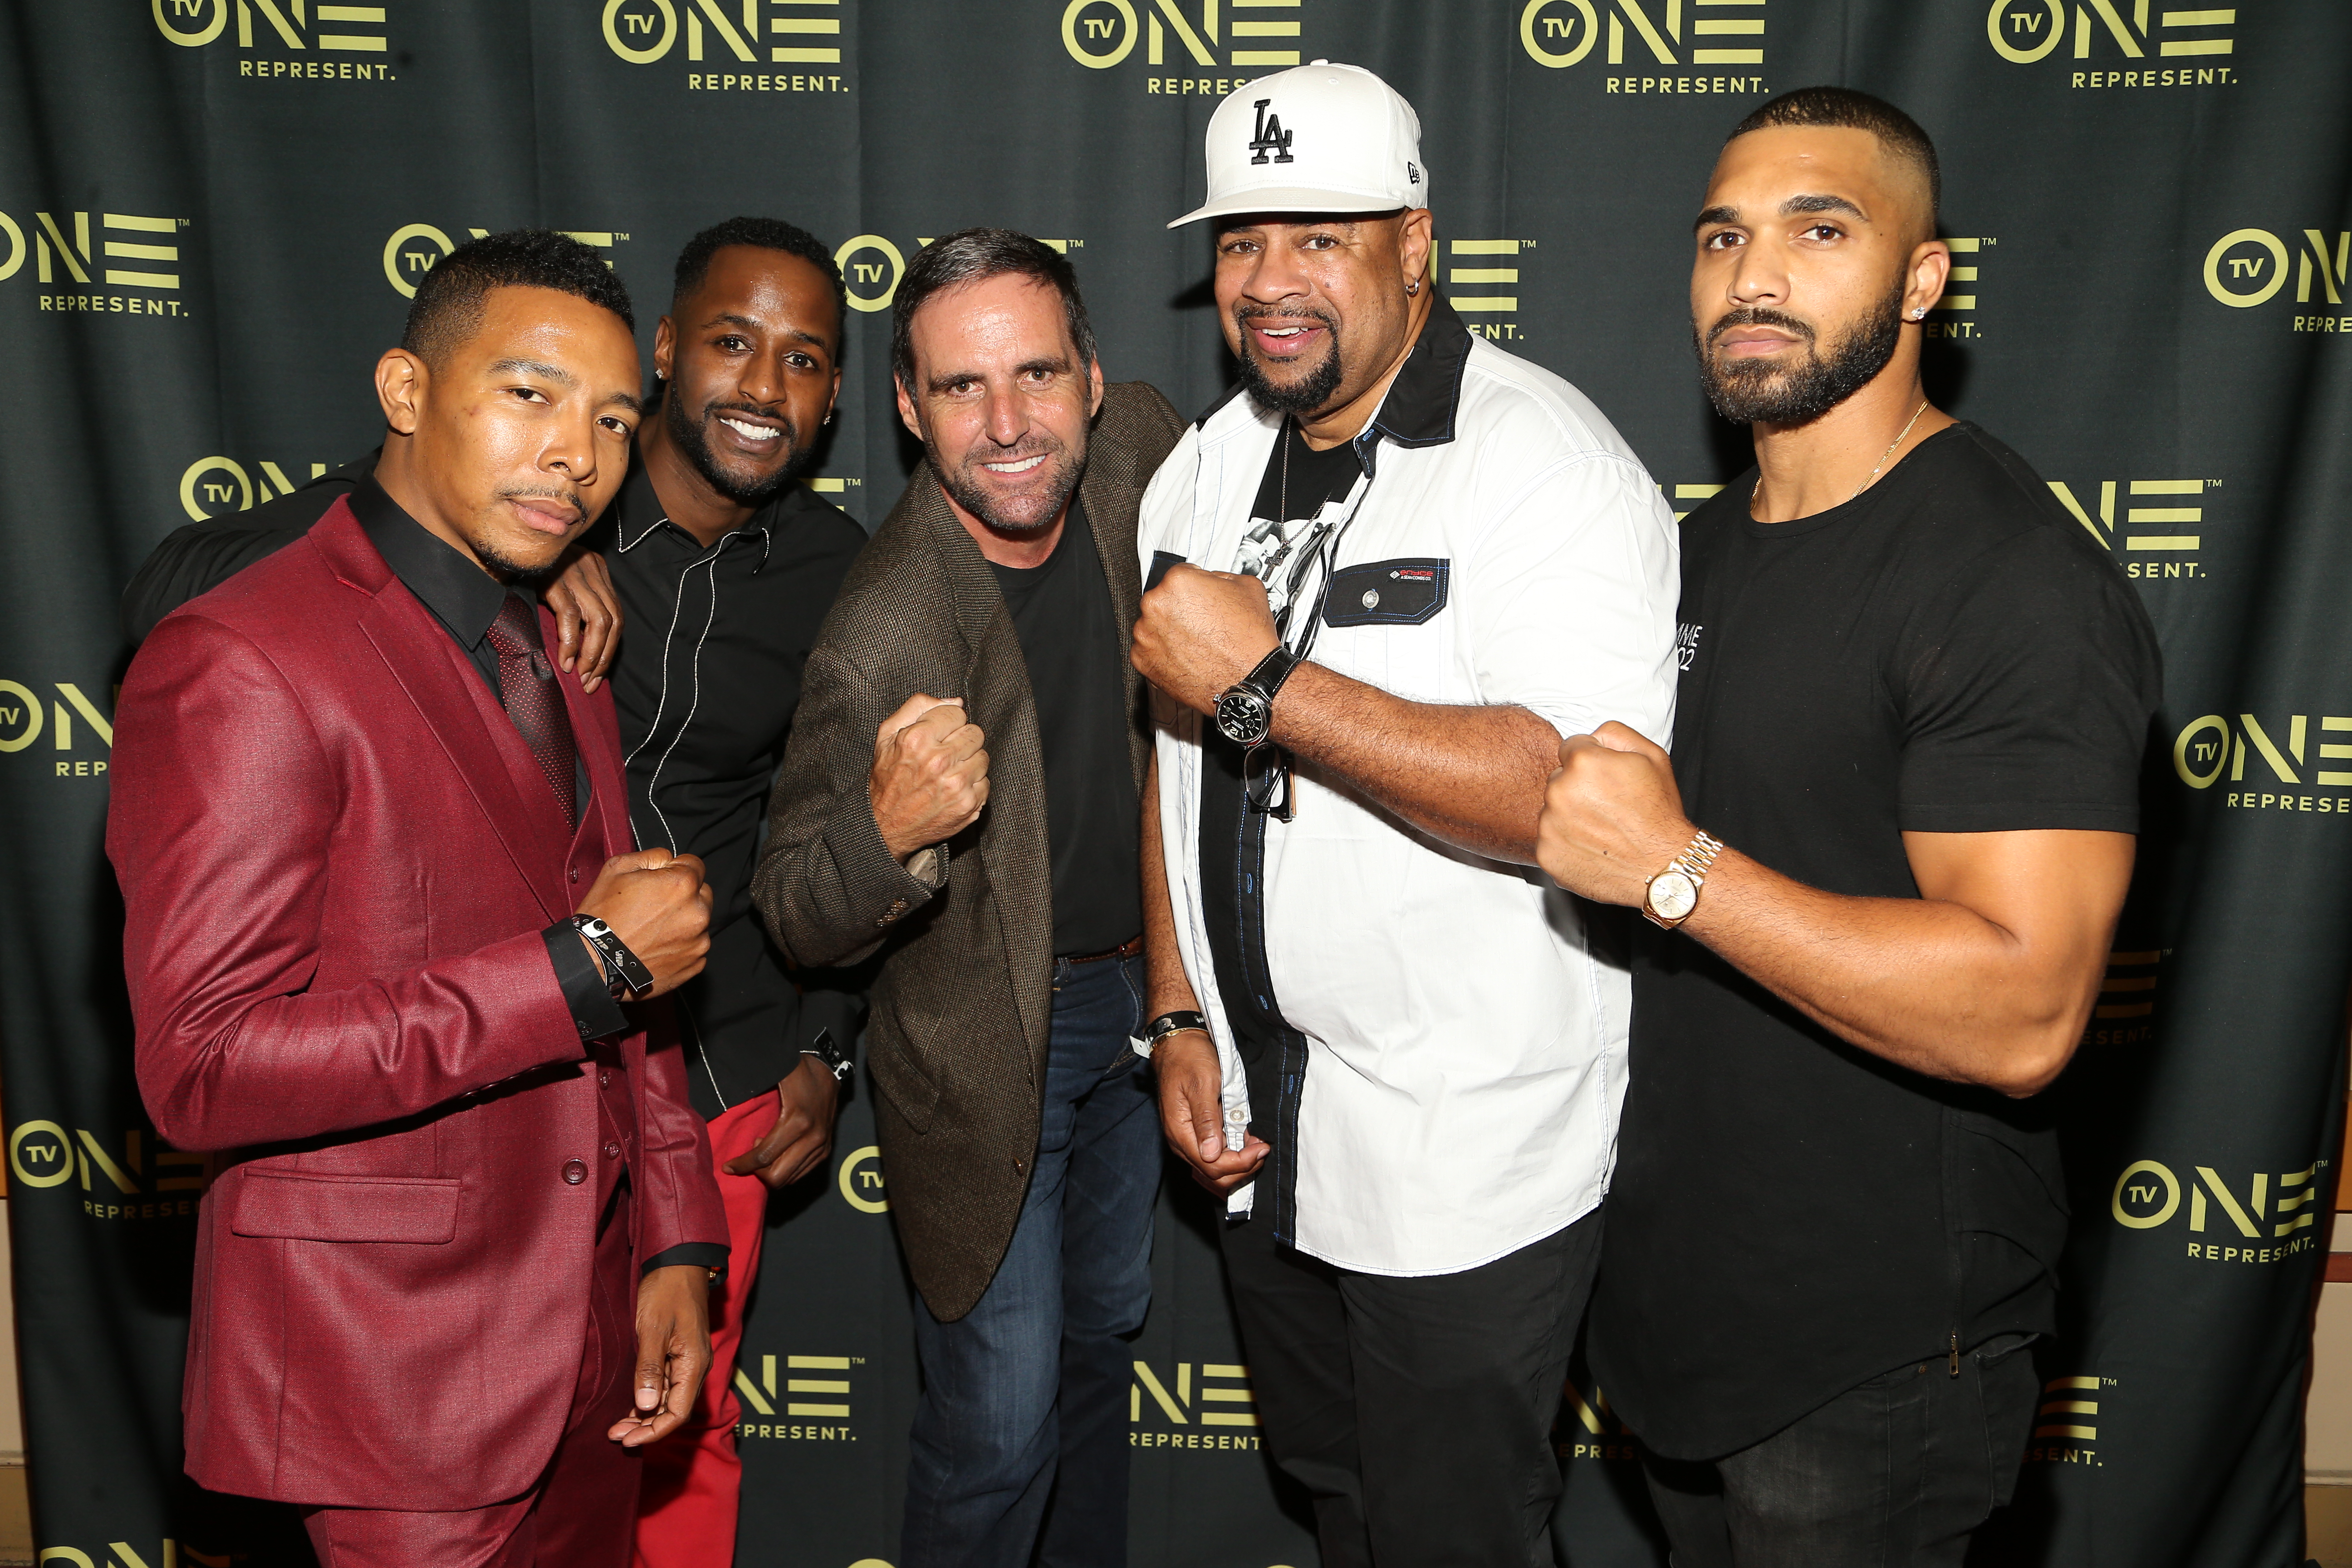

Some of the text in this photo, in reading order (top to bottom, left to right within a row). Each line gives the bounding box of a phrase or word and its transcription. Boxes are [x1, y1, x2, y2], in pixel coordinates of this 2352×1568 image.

[152, 0, 387, 51] ONE
[602, 0, 840, 64] ONE
[624, 15, 655, 34] TV
[1084, 19, 1115, 38] TV
[1543, 18, 1575, 37] TV
[1987, 0, 2235, 64] ONE
[2010, 13, 2043, 32] TV
[1061, 0, 1301, 69] ONE
[1520, 0, 1766, 68] ONE
[240, 61, 396, 80] REPRESENT.
[2073, 68, 2237, 88] REPRESENT.
[689, 74, 848, 92] REPRESENT.
[1148, 78, 1246, 94] REPRES
[1607, 77, 1769, 93] REPRESENT.
[1249, 98, 1293, 165] LA
[853, 264, 884, 283] TV
[2204, 229, 2350, 308] ON
[2229, 258, 2264, 278] TV
[40, 296, 188, 317] REPRESENT.
[2294, 316, 2352, 332] REPRE
[203, 484, 233, 502] TV
[2046, 480, 2203, 550] NE
[2127, 563, 2205, 578] SENT.
[0, 680, 113, 752] ON
[2195, 742, 2218, 761] TV
[2228, 793, 2350, 813] REPRESE
[26, 1146, 57, 1162] TV
[2112, 1160, 2315, 1239] ONE
[2129, 1186, 2157, 1203] TV
[2188, 1236, 2313, 1262] REPRESENT.
[735, 1355, 850, 1417] NE
[1130, 1361, 1263, 1426] NE
[745, 1424, 856, 1441] PRESENT.
[1129, 1432, 1262, 1450] REPRESENT
